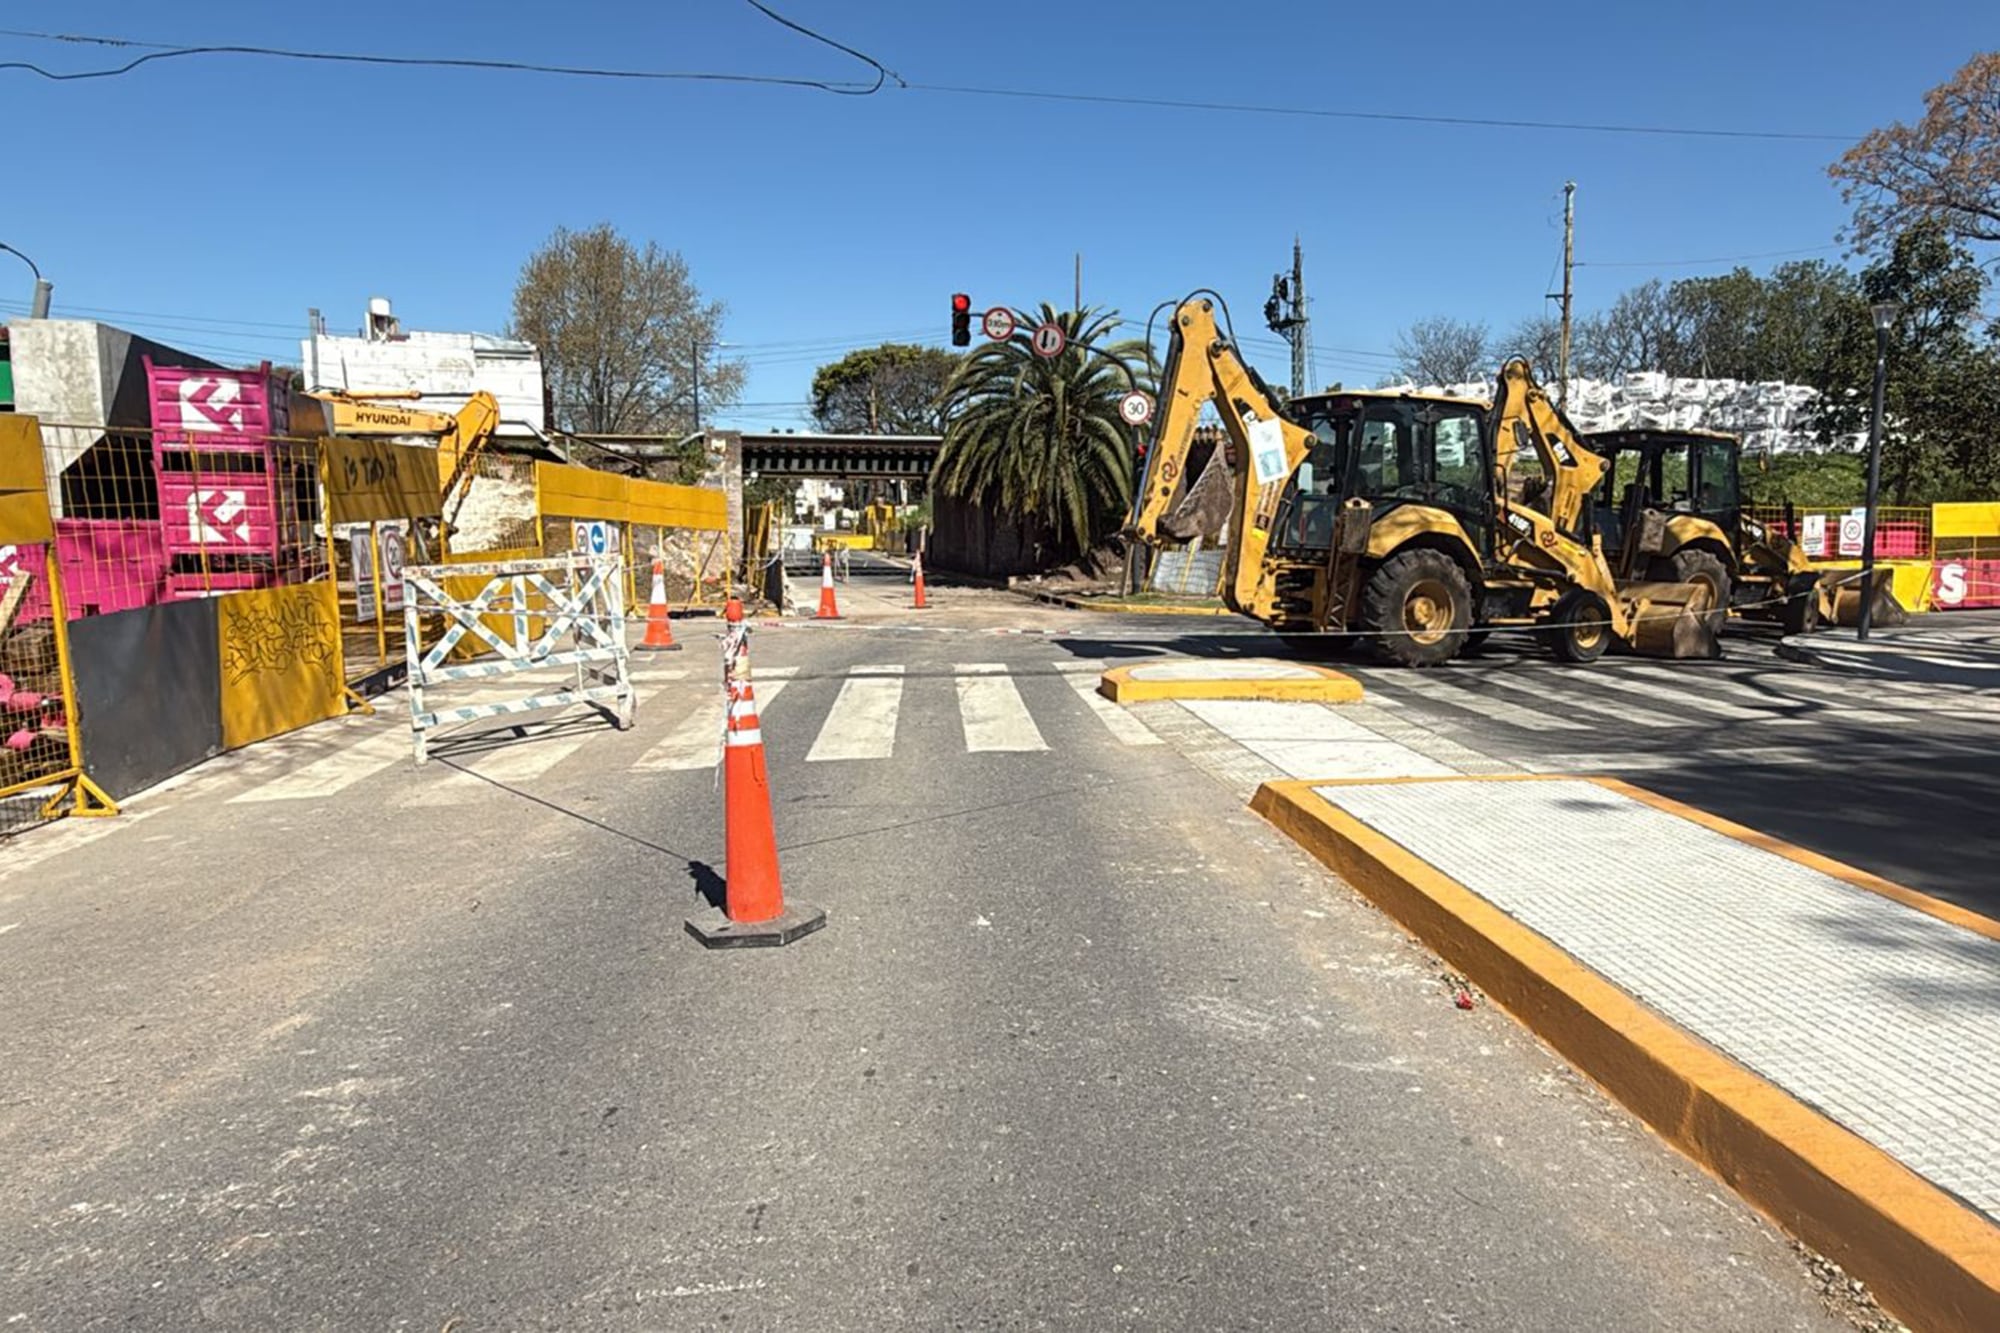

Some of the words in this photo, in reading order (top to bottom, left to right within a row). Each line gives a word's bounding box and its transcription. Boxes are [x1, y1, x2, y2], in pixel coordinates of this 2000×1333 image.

[1127, 401, 1145, 416] 30
[355, 411, 412, 427] HYUNDAI
[1938, 563, 1968, 604] S
